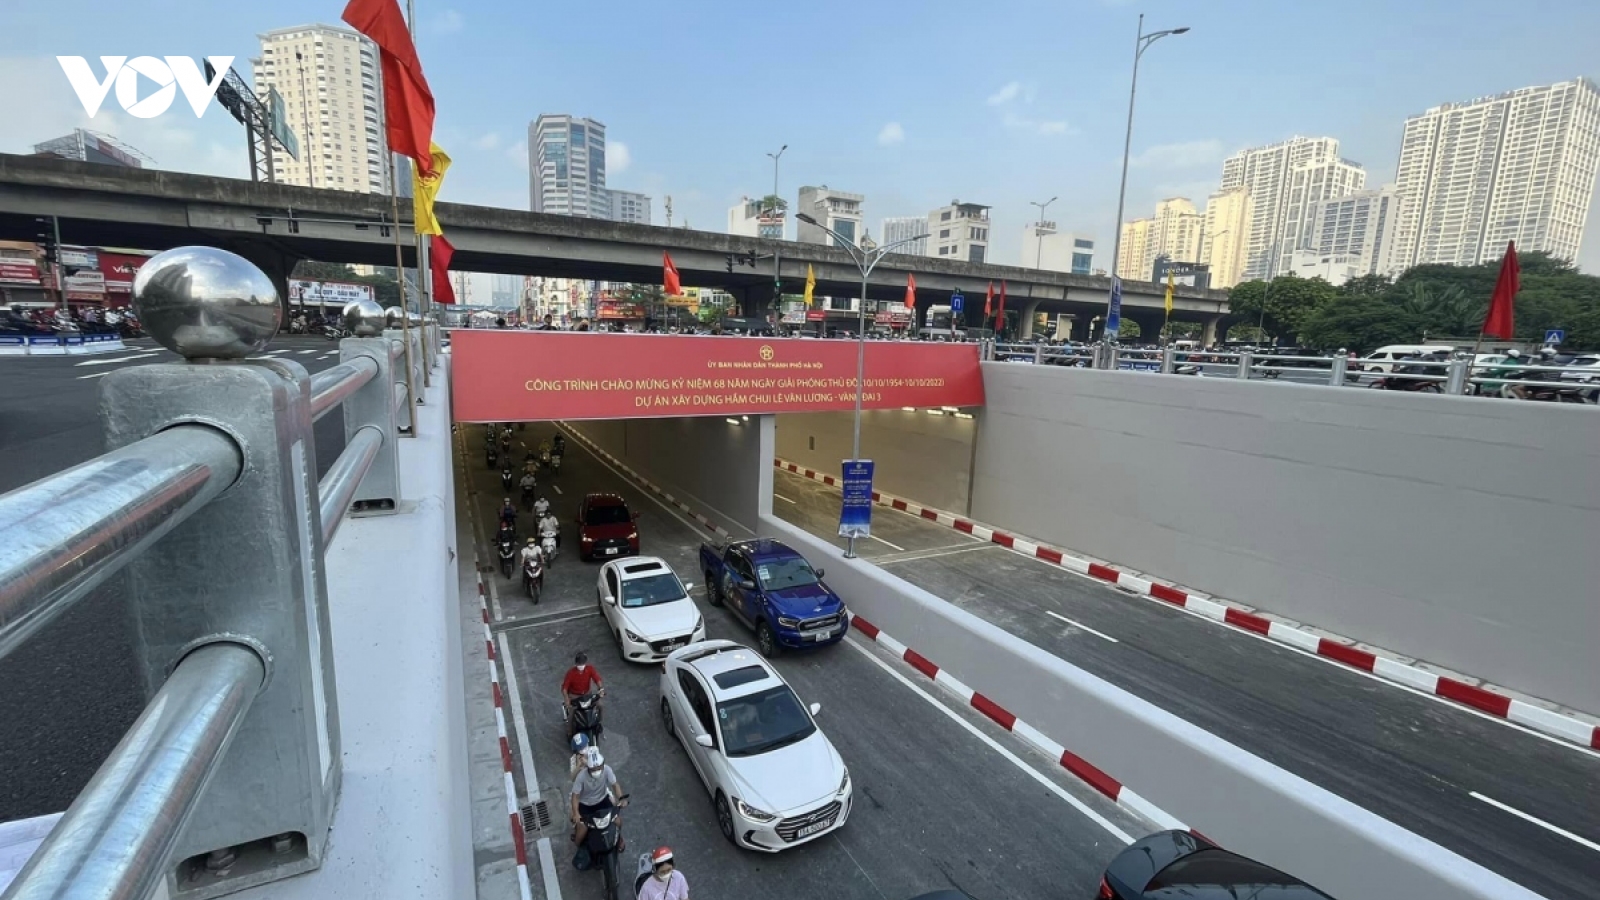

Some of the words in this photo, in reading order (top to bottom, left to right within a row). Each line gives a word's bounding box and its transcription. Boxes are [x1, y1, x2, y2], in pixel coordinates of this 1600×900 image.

[767, 361, 788, 369] THÀNH
[789, 360, 802, 369] PHỐ
[813, 361, 823, 370] NỘI
[524, 378, 562, 391] CÔNG
[563, 378, 598, 391] TRÌNH
[600, 377, 633, 391] CHÀO
[635, 378, 670, 390] MỪNG
[671, 377, 684, 389] KỶ
[686, 377, 712, 390] NIỆM
[713, 379, 725, 388] 68
[727, 377, 749, 388] NĂM
[751, 377, 776, 388] NGÀY
[777, 377, 796, 388] GIẢI
[797, 377, 828, 388] PHÓNG
[828, 376, 845, 388] THỦ
[635, 395, 652, 409] DỰ
[654, 393, 669, 406] ÁN
[671, 393, 691, 406] XÂY
[692, 393, 723, 407] DỰNG
[724, 391, 748, 404] HẦM
[749, 393, 771, 404] CHUI
[772, 391, 783, 403] LÊ
[784, 392, 802, 402] VĂN
[803, 392, 833, 403] LƯƠNG
[877, 392, 882, 401] 3
